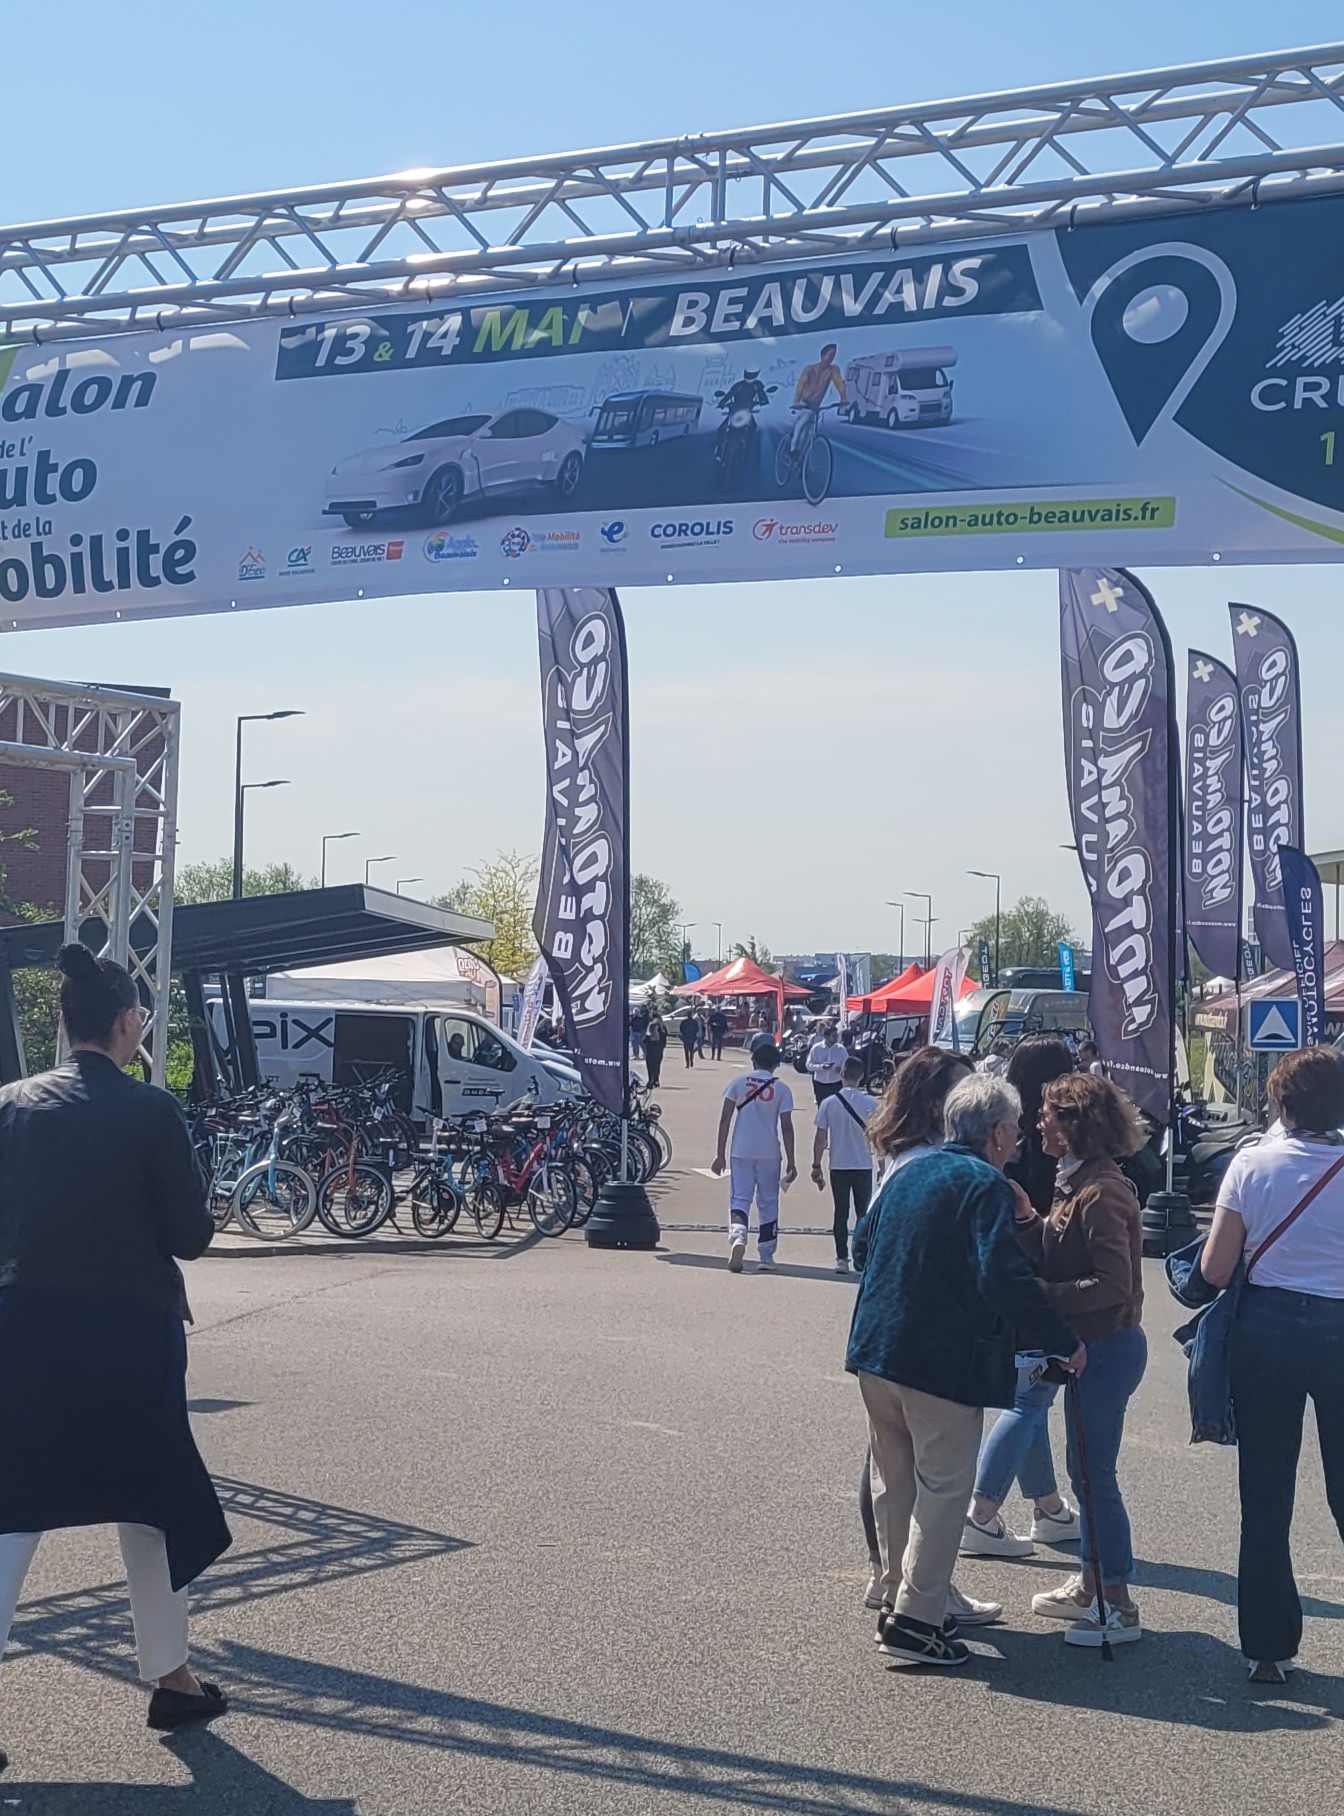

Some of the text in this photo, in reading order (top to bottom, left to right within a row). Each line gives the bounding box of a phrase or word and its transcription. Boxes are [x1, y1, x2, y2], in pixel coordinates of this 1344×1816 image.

[313, 325, 372, 367] 13
[372, 341, 393, 362] &
[403, 314, 463, 359] 14
[472, 303, 590, 354] MAI
[669, 257, 982, 337] BEAUVAIS
[19, 437, 34, 458] l'
[1319, 430, 1339, 466] 1
[898, 501, 1160, 532] salon-auto-beauvais.fr
[11, 519, 33, 539] de
[35, 517, 53, 538] la
[650, 520, 734, 538] COROLIS
[778, 521, 839, 537] transdev
[331, 544, 386, 560] Beauvais
